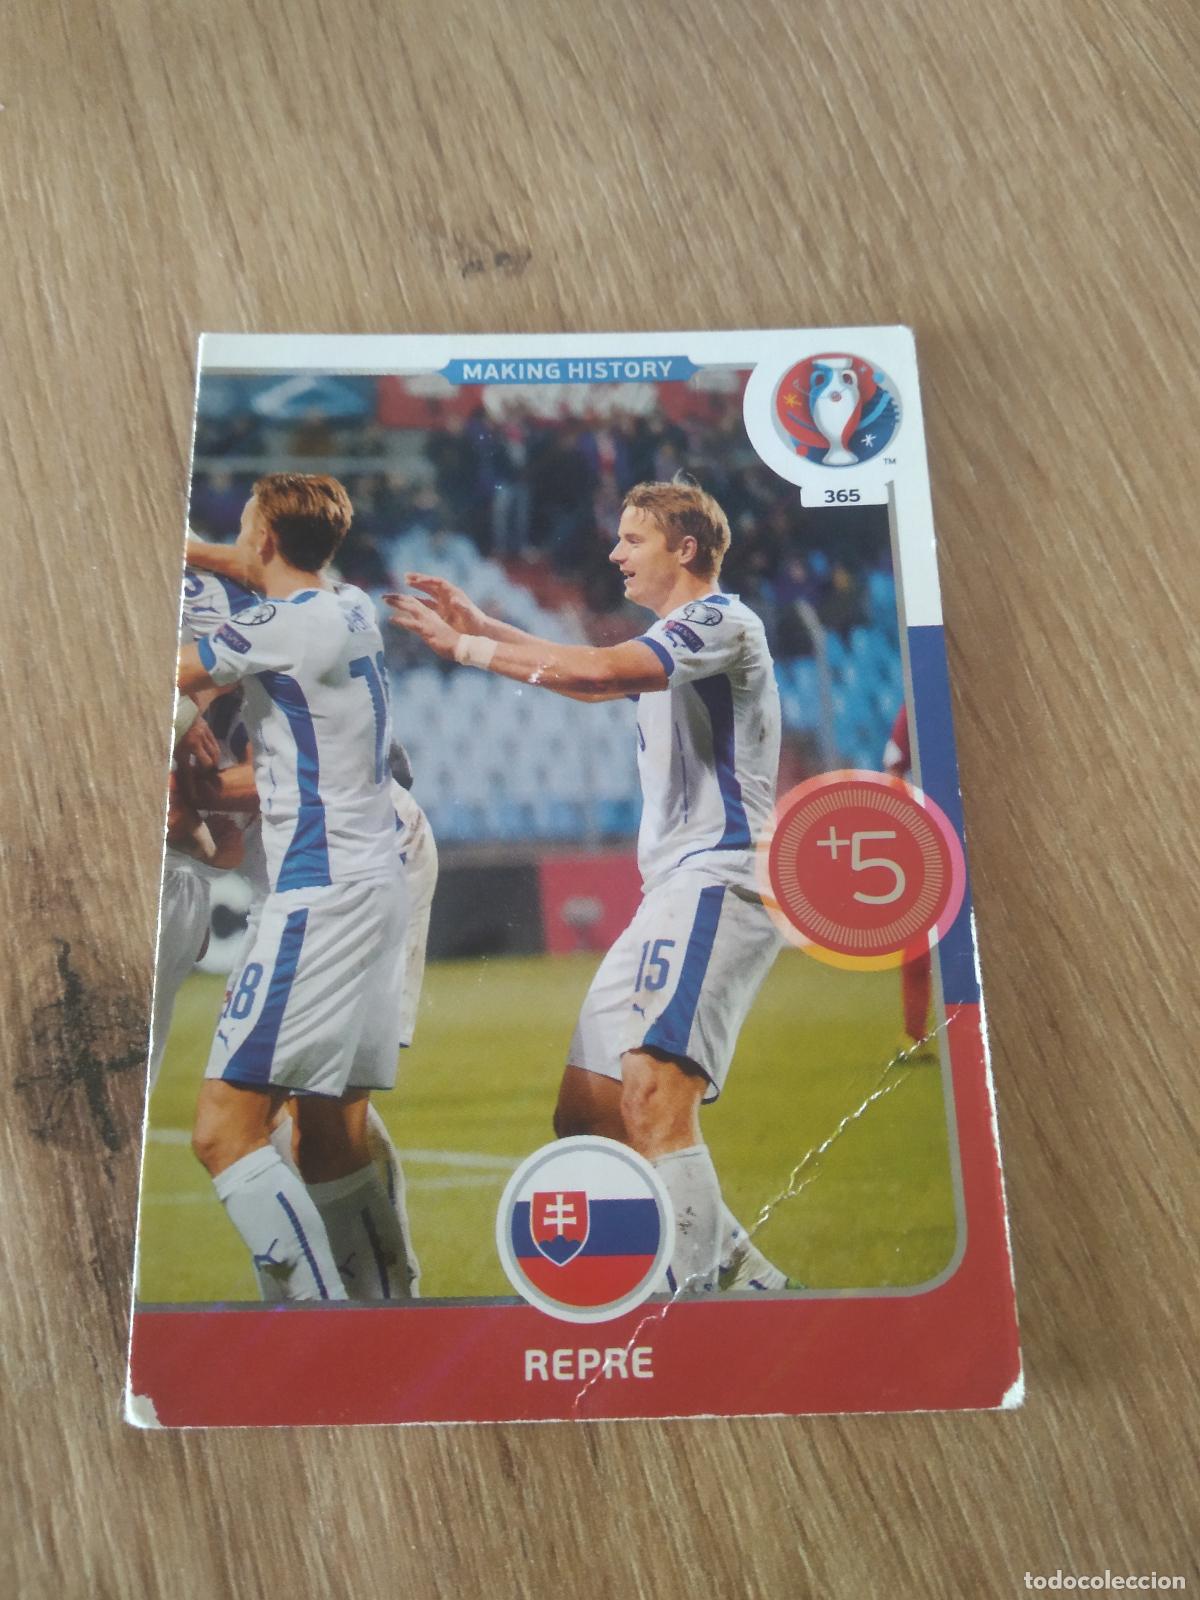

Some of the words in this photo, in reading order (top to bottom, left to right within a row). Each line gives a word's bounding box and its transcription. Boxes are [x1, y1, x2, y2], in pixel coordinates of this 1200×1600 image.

[462, 363, 561, 380] MAKING
[568, 360, 673, 379] HISTORY
[824, 489, 861, 503] 365
[816, 826, 906, 905] +5
[635, 939, 676, 993] 15
[524, 1346, 655, 1382] REPRE
